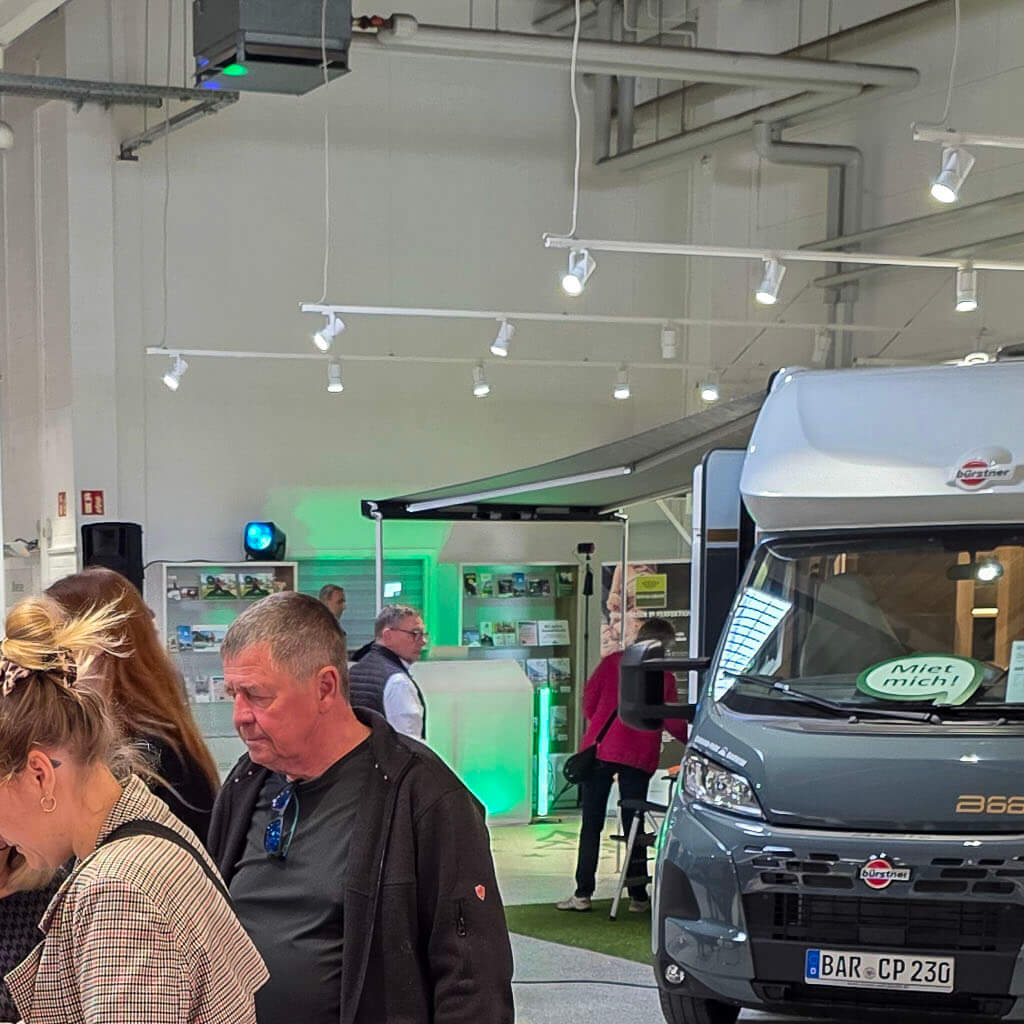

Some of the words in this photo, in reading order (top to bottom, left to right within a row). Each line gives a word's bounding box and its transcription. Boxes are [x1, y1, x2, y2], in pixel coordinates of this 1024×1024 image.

[891, 664, 955, 674] Miet
[883, 675, 960, 688] mich!
[862, 867, 908, 880] bürstner
[821, 954, 862, 978] BAR
[879, 958, 906, 980] CP
[910, 960, 951, 983] 230
